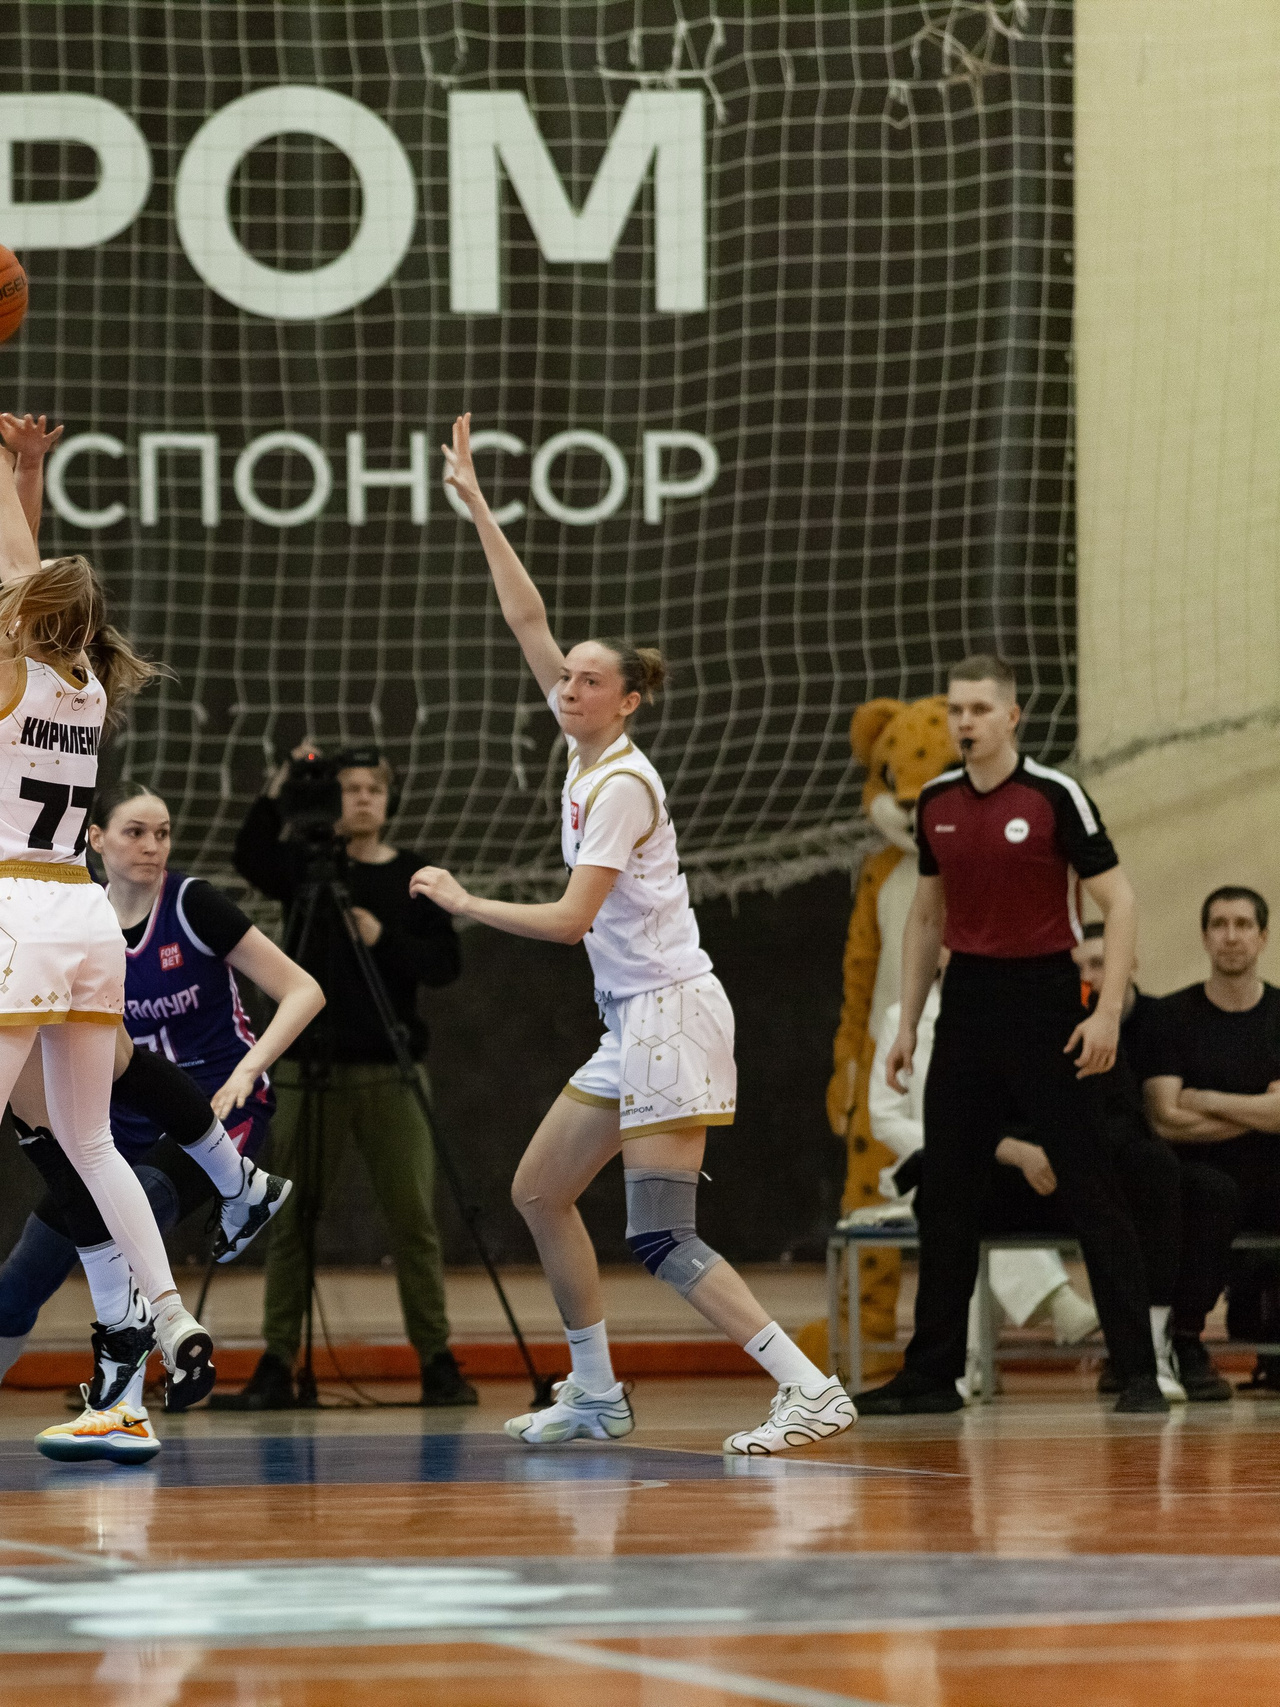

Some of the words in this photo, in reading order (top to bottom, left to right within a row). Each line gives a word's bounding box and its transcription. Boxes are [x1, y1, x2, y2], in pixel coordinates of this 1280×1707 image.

[44, 429, 720, 530] СПОНСОР
[19, 776, 96, 857] 77
[160, 945, 179, 958] FON
[162, 954, 181, 968] BET
